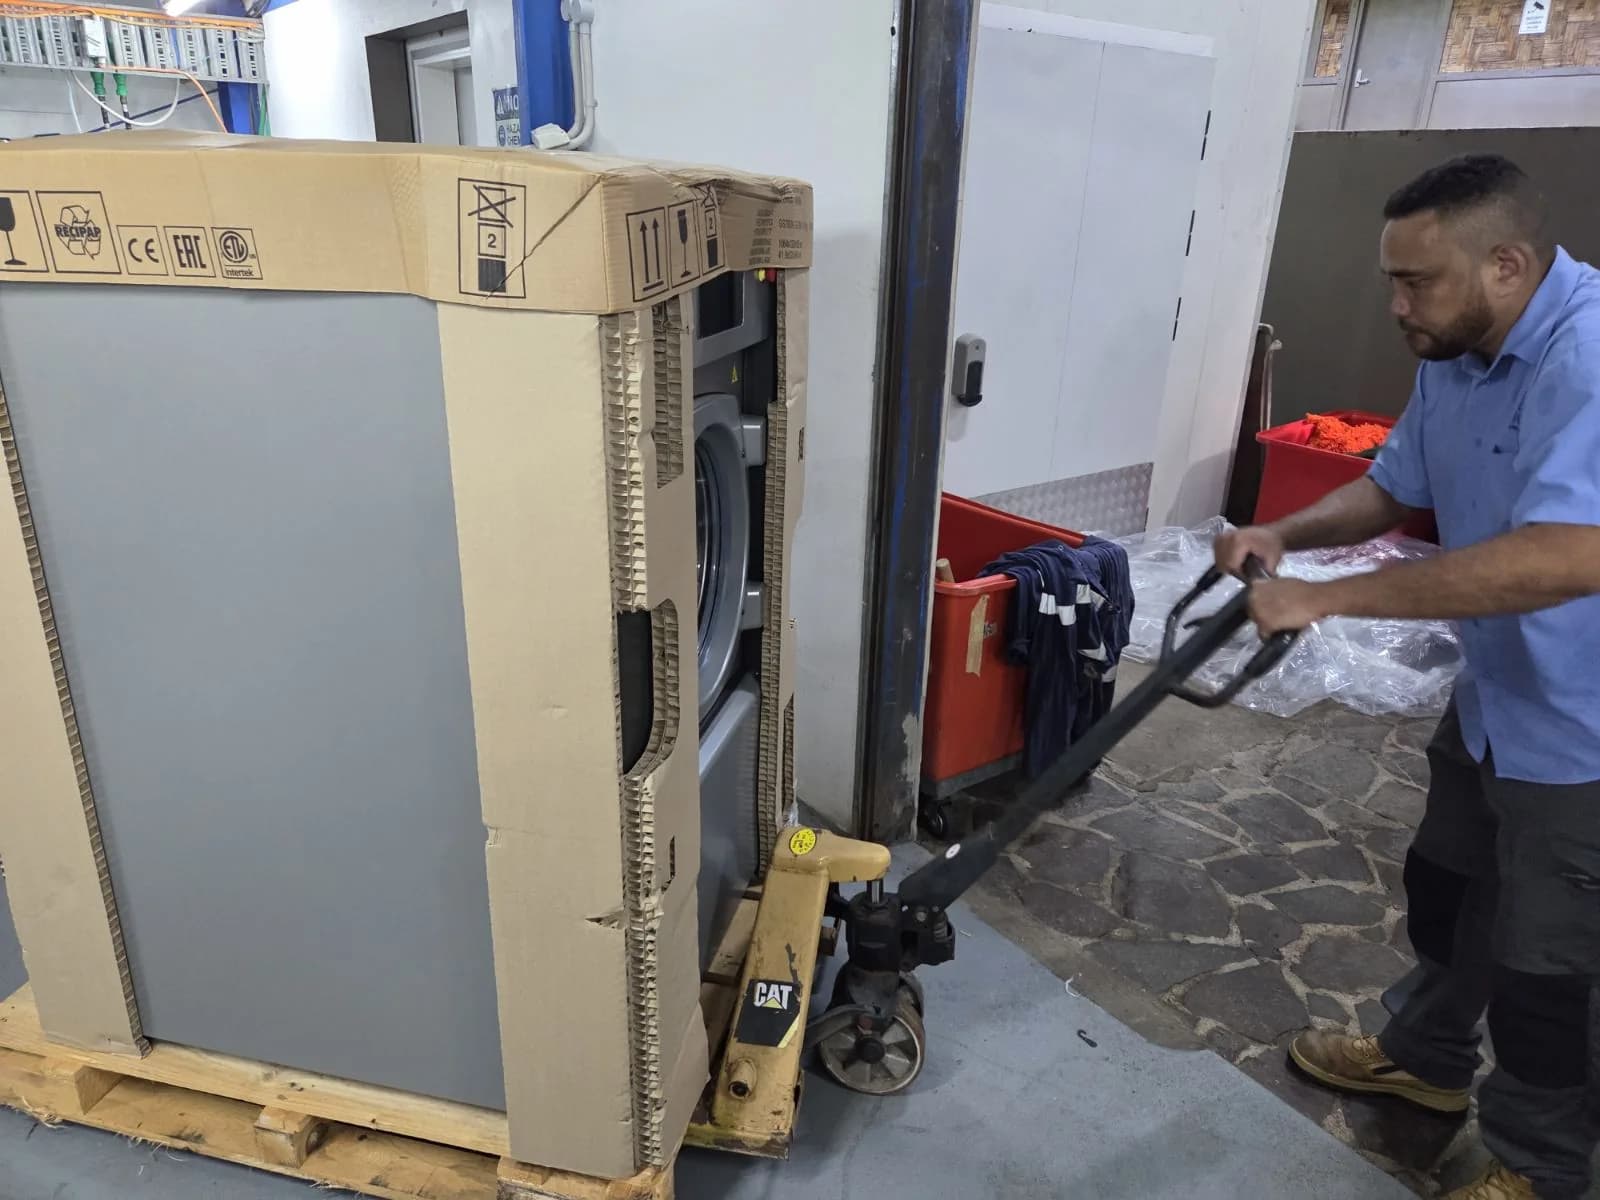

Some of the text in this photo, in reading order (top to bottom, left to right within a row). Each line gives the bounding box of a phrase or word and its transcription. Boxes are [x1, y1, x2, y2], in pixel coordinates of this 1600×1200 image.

[54, 225, 101, 238] RECIPAP
[487, 234, 497, 249] 2
[128, 238, 160, 263] CE
[753, 982, 792, 1010] CAT
